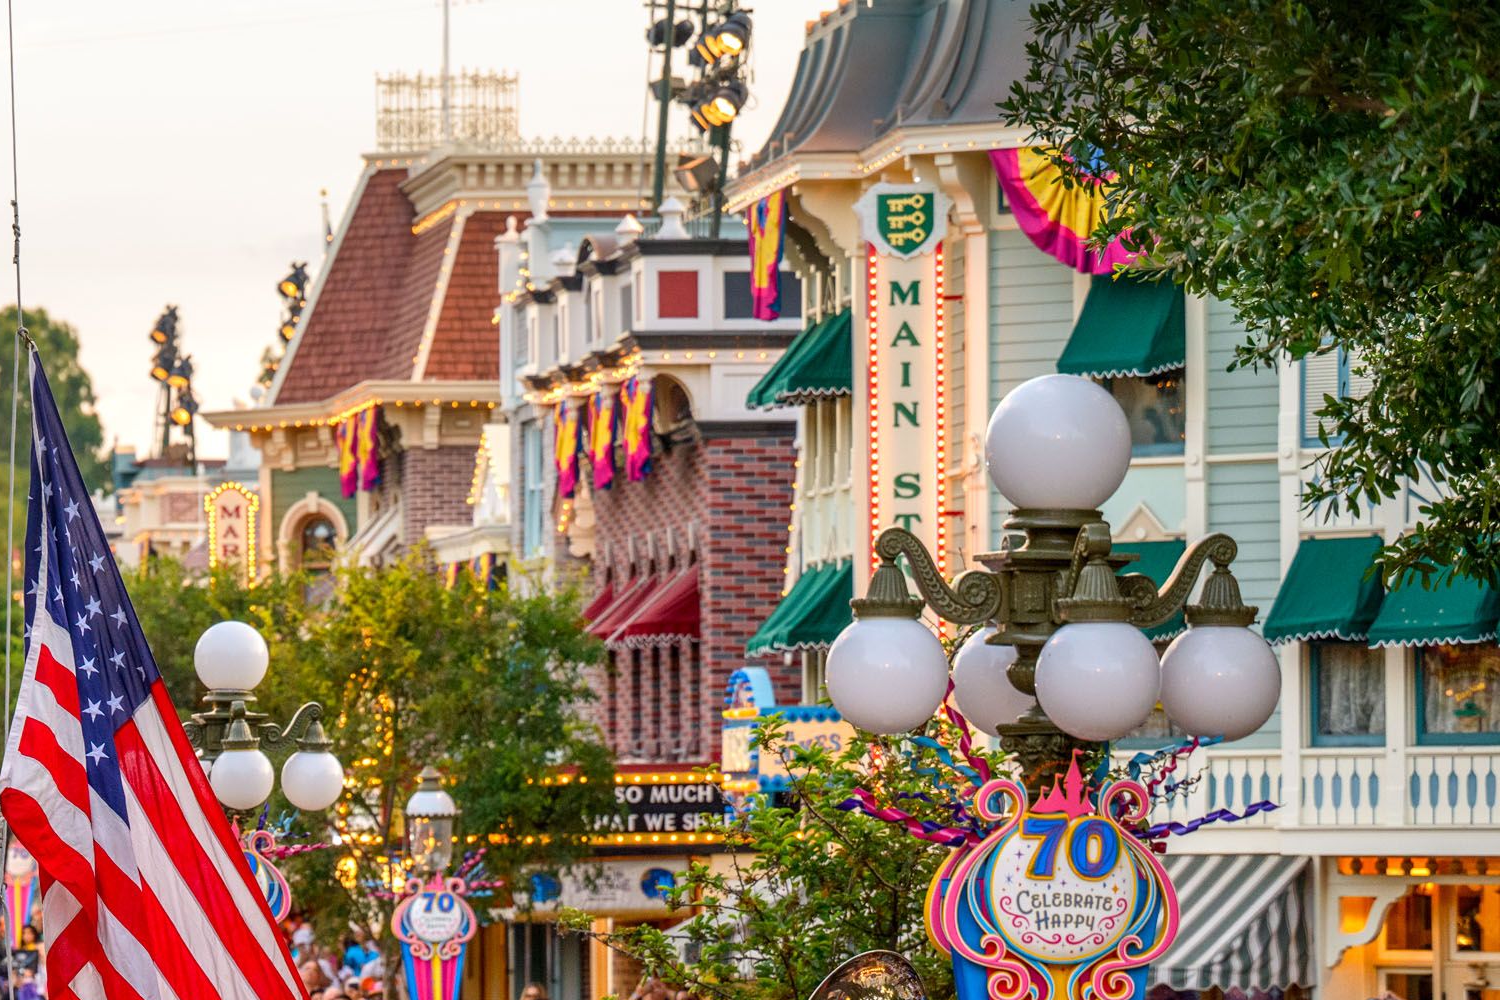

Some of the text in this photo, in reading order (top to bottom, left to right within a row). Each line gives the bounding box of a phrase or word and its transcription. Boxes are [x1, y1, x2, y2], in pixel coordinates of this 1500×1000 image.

[889, 280, 922, 577] MAIN ST
[221, 505, 241, 560] MAR
[614, 785, 713, 803] SO MUCH
[644, 812, 676, 831] WE
[1019, 812, 1122, 882] 70
[422, 892, 455, 913] 70
[1016, 890, 1113, 914] CELEBRATE
[1035, 910, 1095, 931] HAPPY
